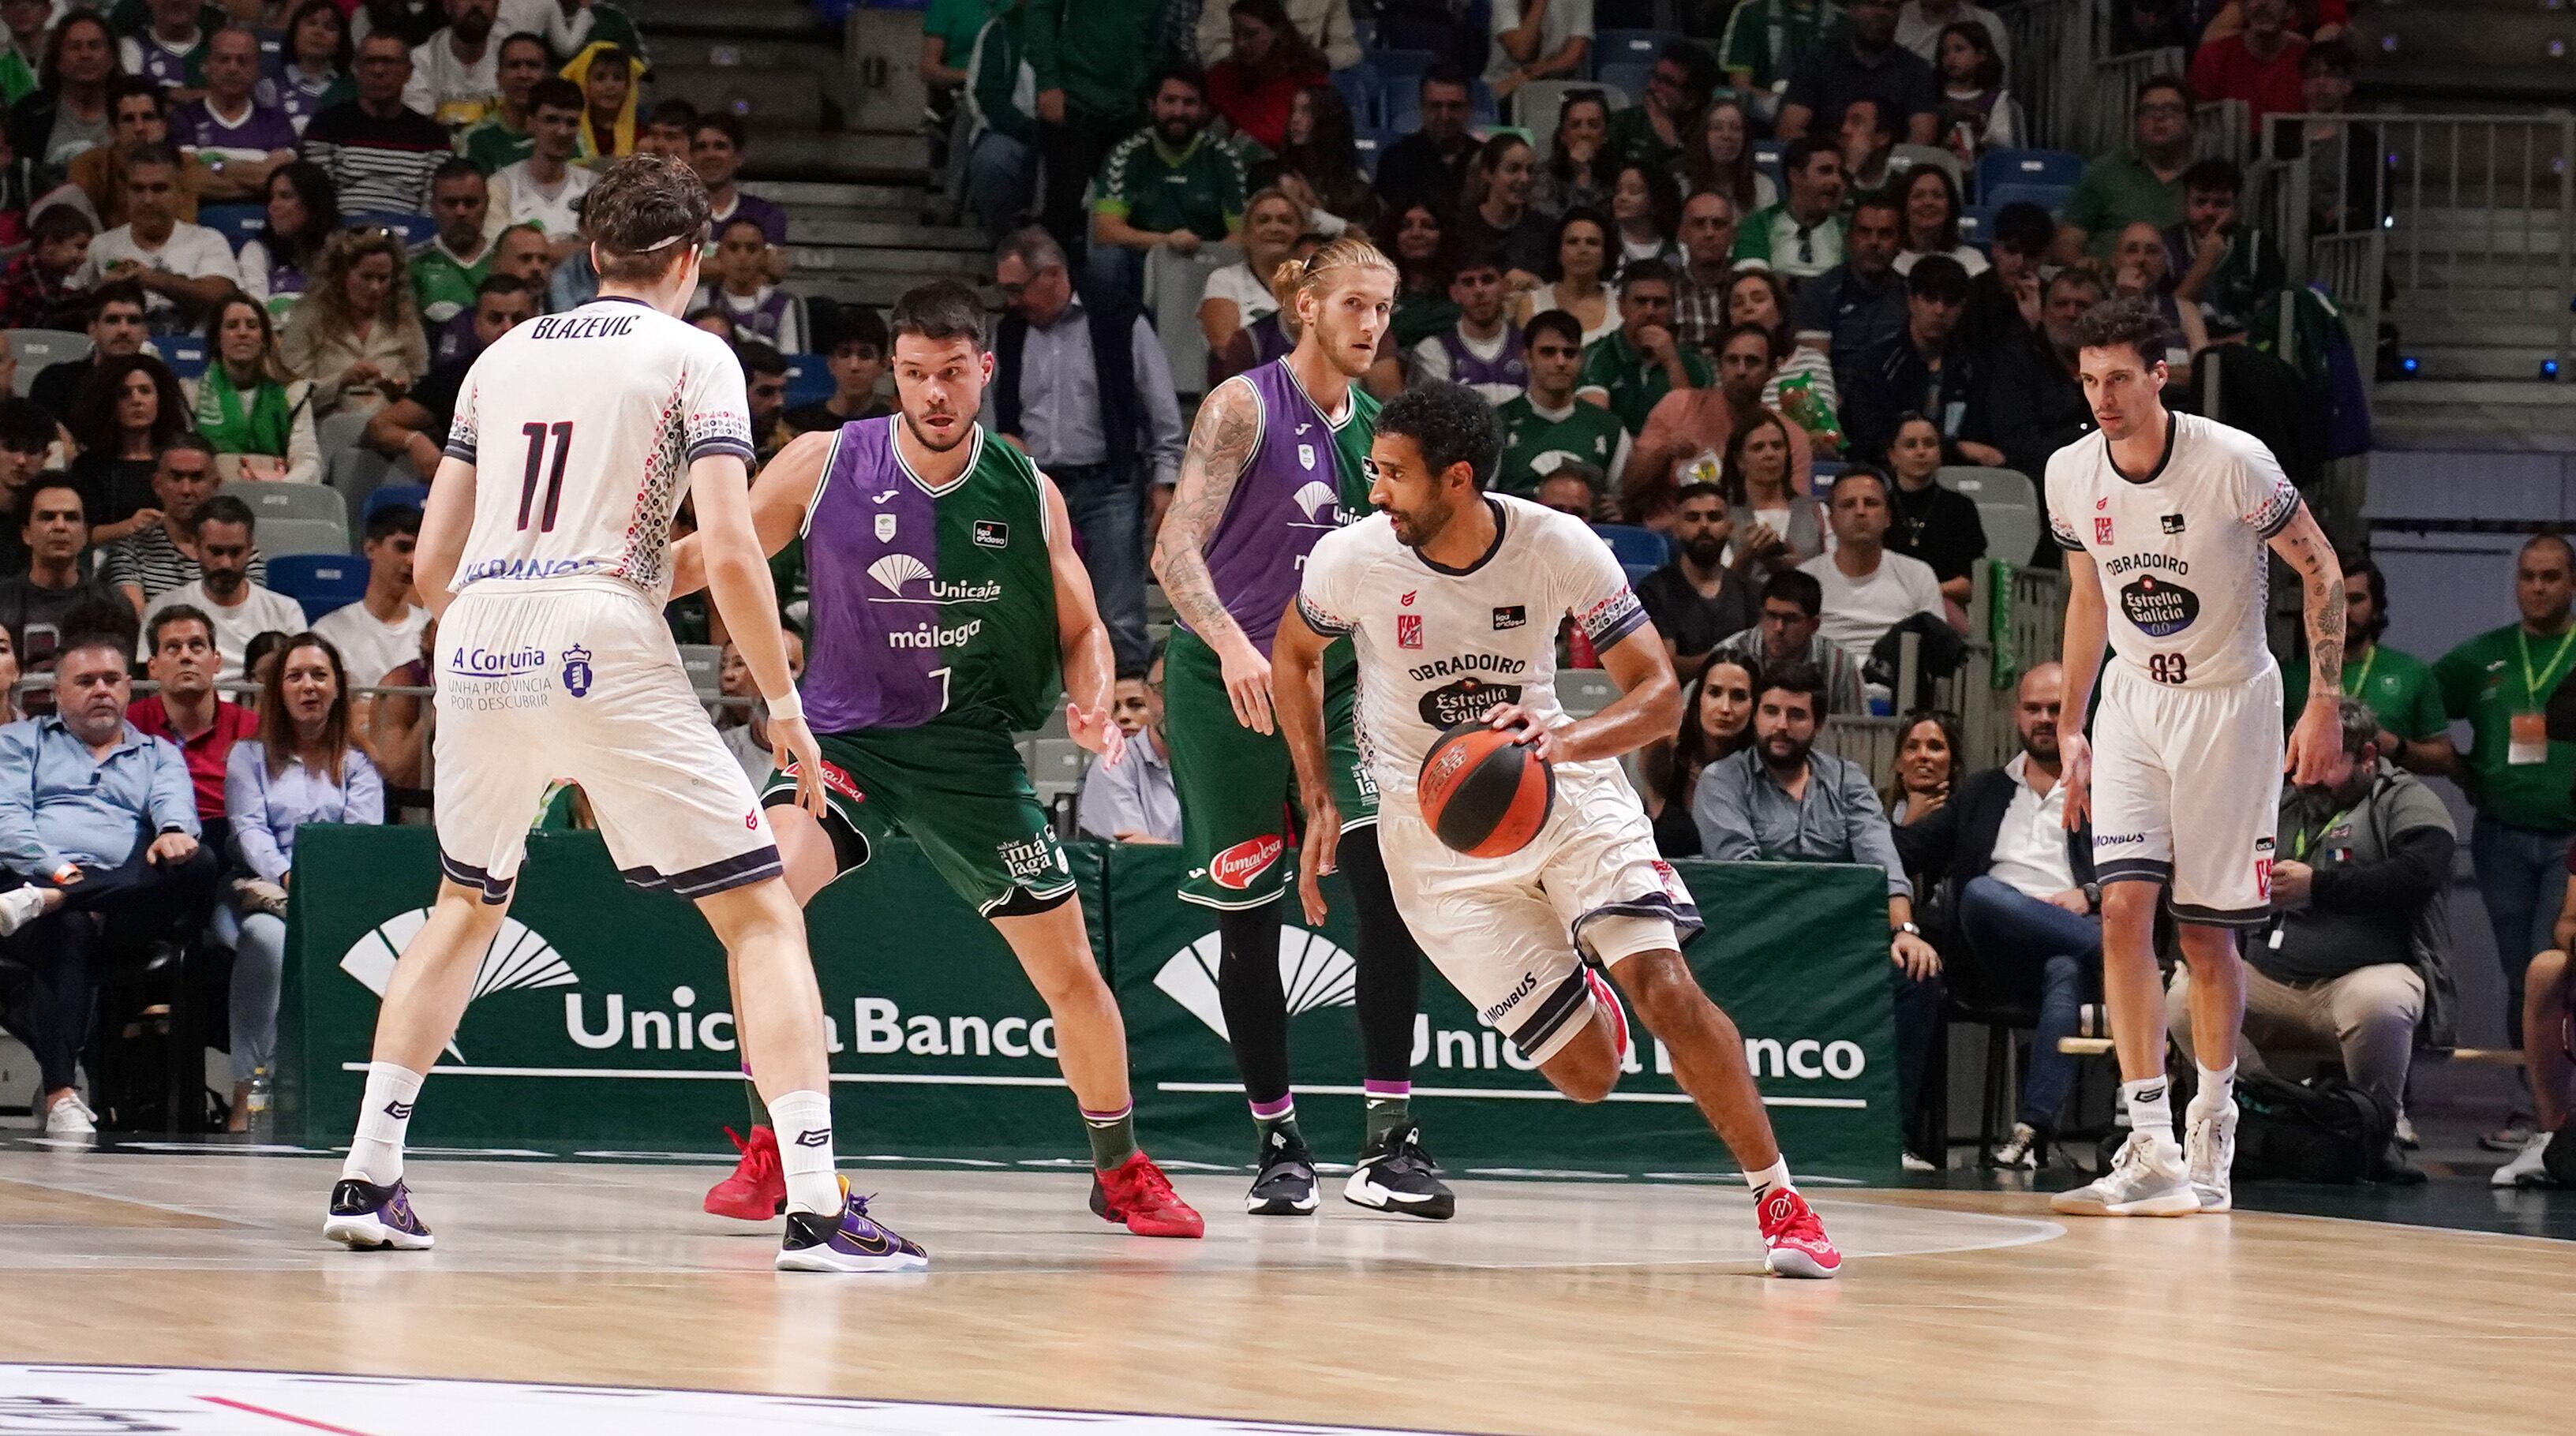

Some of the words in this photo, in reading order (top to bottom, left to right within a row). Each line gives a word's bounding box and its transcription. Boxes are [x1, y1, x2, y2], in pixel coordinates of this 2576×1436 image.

[517, 421, 573, 533] 11
[2106, 553, 2188, 576] OBRADOIRO
[929, 580, 1002, 599] Unicaja
[2125, 592, 2183, 607] Estrella
[2131, 606, 2185, 623] Galicia
[889, 619, 982, 648] málaga
[452, 647, 463, 668] A
[471, 646, 545, 670] Coruña
[1409, 654, 1526, 682] OBRADOIRO
[448, 679, 480, 695] UNHA
[485, 678, 552, 694] PROVINCIA
[928, 667, 951, 712] 7
[451, 695, 474, 710] POR
[478, 694, 549, 711] DESCUBRIR
[1436, 688, 1507, 709] Estrella
[1484, 971, 1537, 1025] MONBUS
